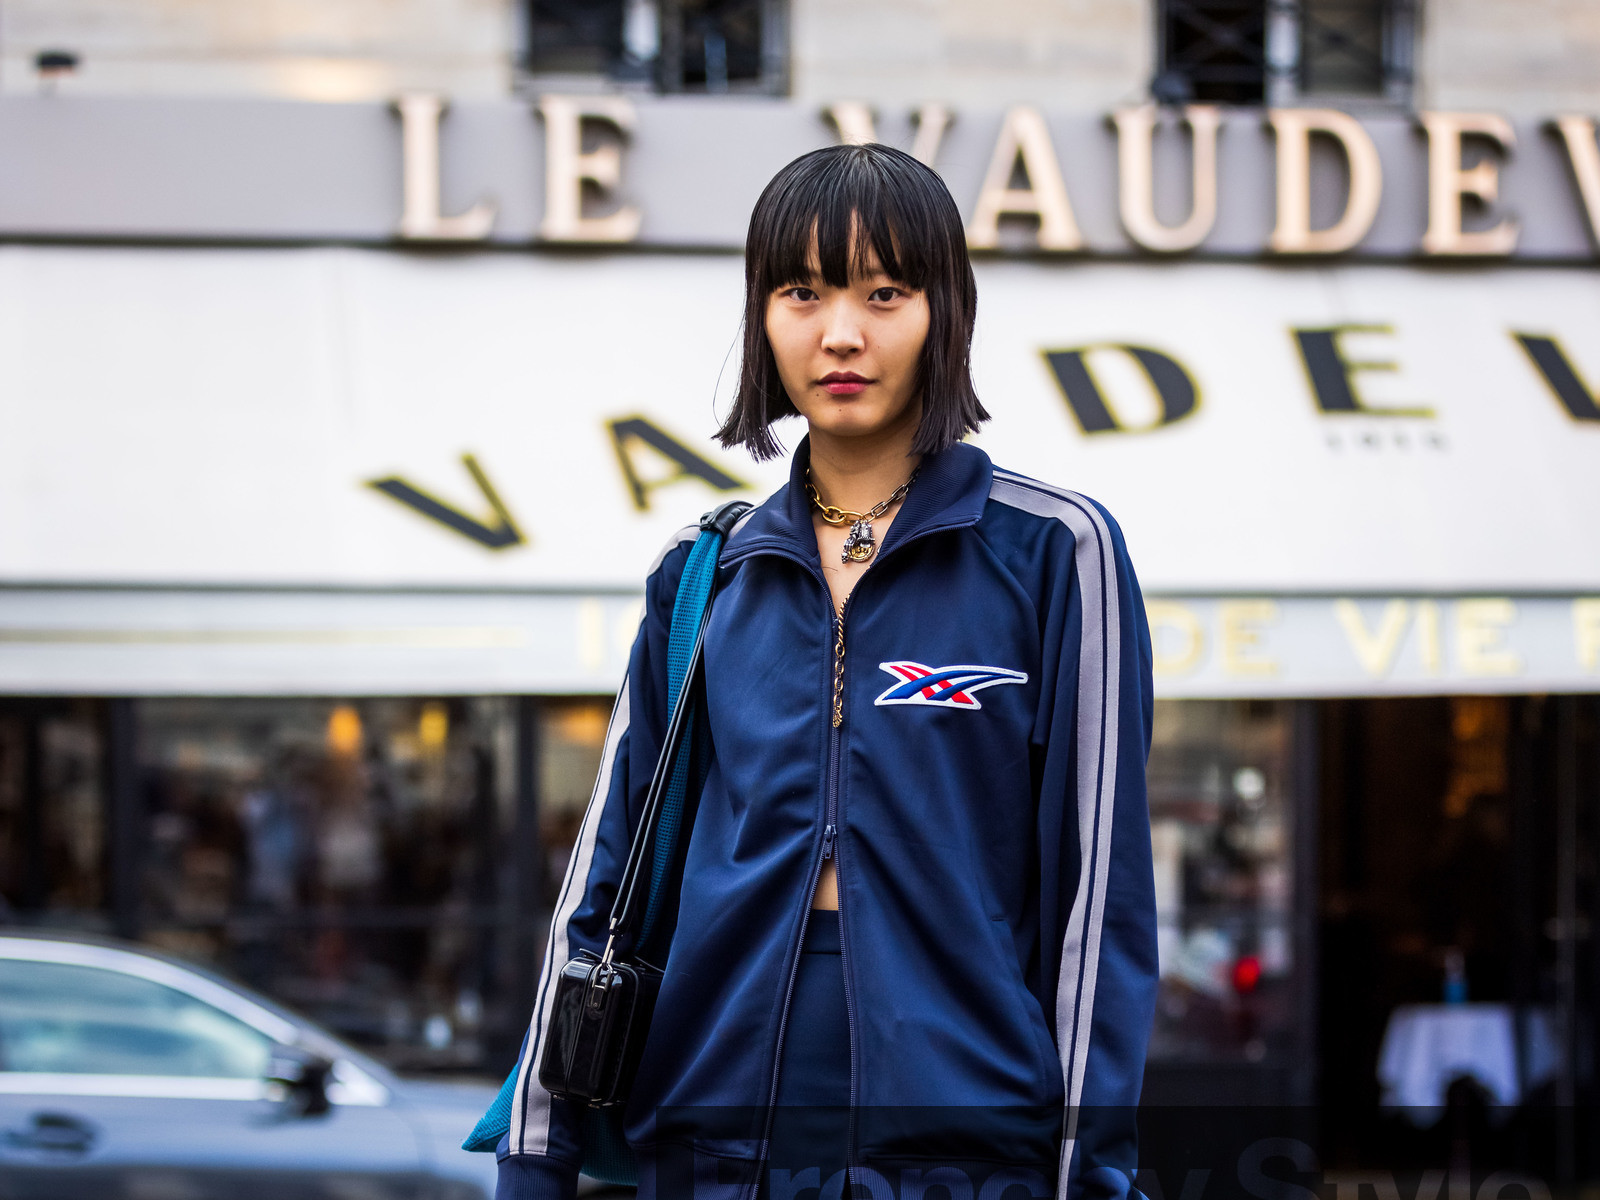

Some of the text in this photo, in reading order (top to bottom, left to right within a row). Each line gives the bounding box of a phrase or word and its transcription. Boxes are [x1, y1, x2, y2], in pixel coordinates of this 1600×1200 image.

[397, 95, 642, 242] LE
[362, 324, 1600, 552] VADEV
[1335, 599, 1521, 676] VIE
